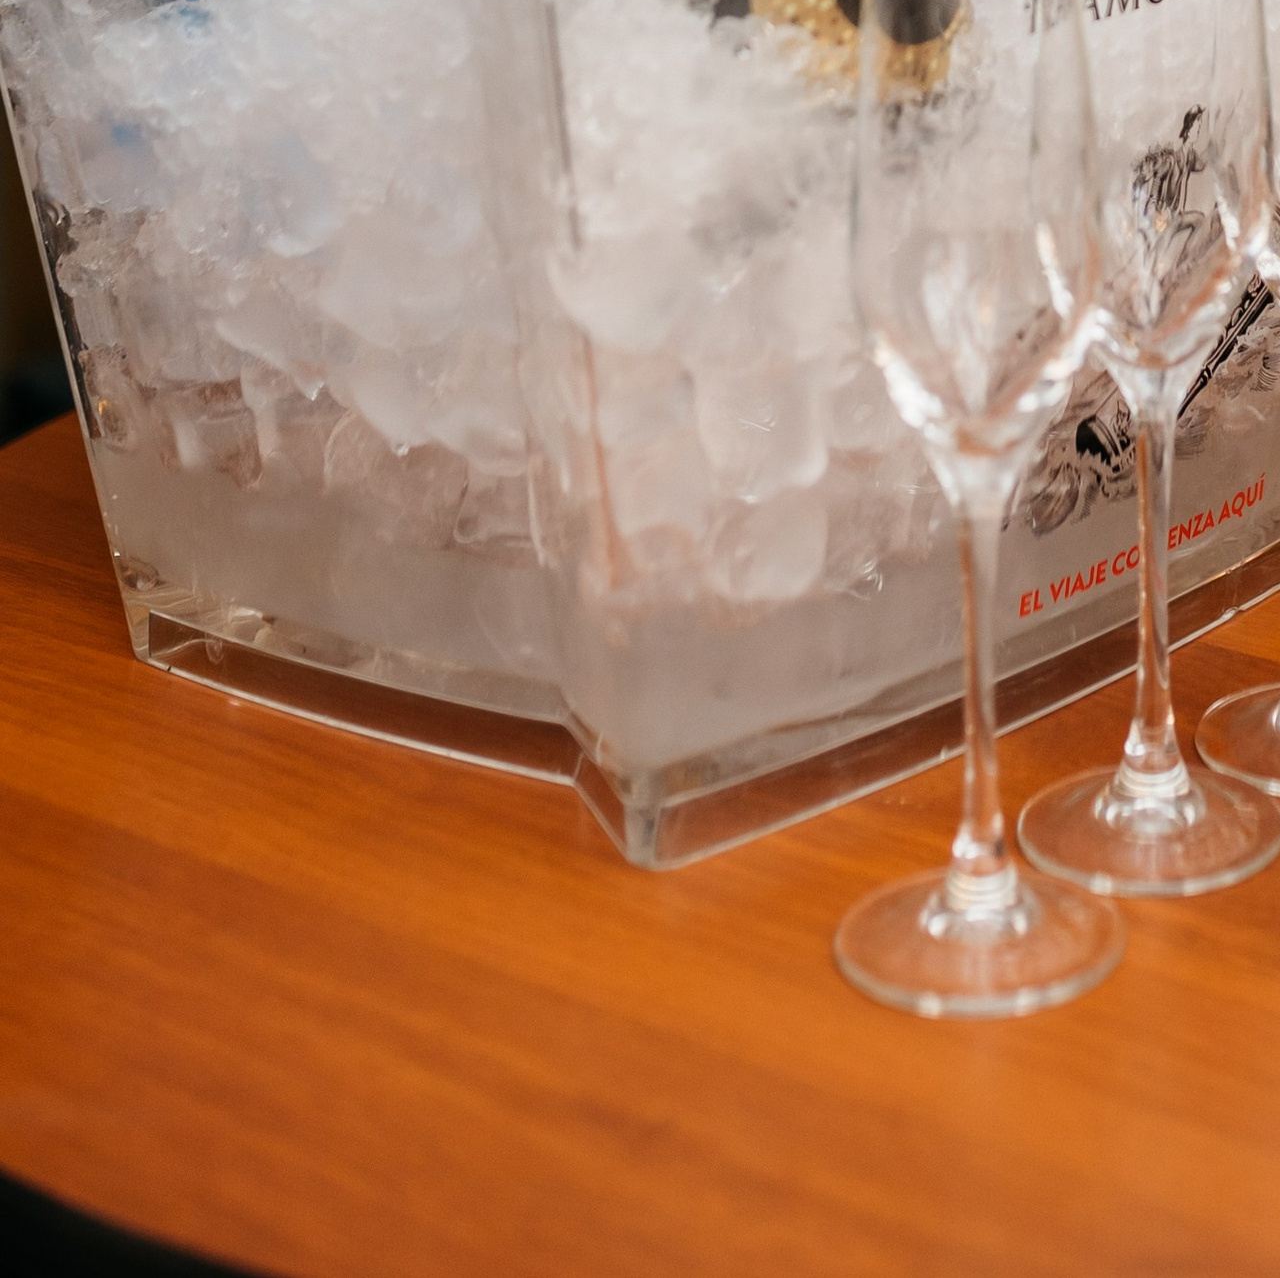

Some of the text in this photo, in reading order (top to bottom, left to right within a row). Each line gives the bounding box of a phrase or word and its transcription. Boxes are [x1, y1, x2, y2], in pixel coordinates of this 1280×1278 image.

[1018, 472, 1266, 619] EL VIAJE COENZA AQUÍ
